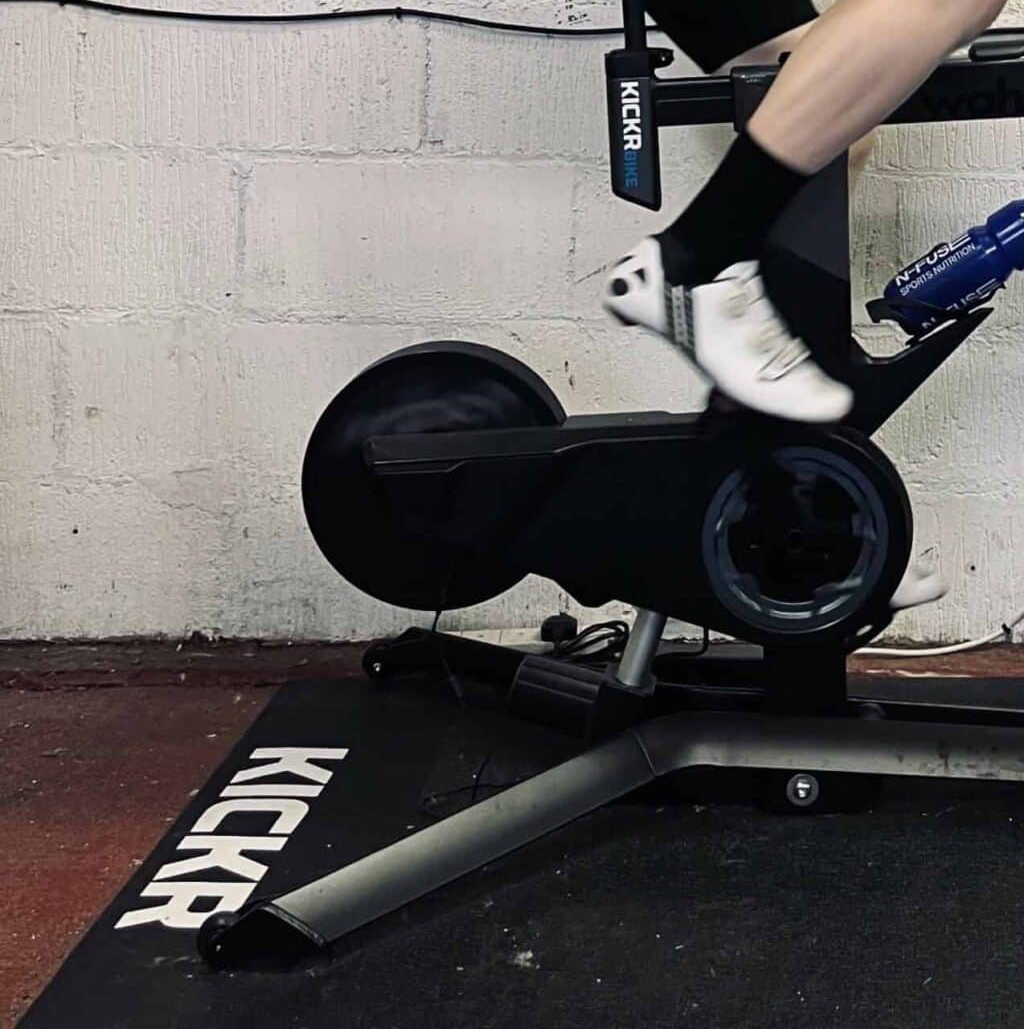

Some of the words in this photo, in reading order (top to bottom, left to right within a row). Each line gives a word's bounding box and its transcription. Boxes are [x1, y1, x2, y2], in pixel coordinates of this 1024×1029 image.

[620, 81, 642, 151] KICKR
[900, 270, 934, 297] SPORTS
[932, 242, 977, 276] NUTRITION
[113, 747, 350, 929] KICKR
